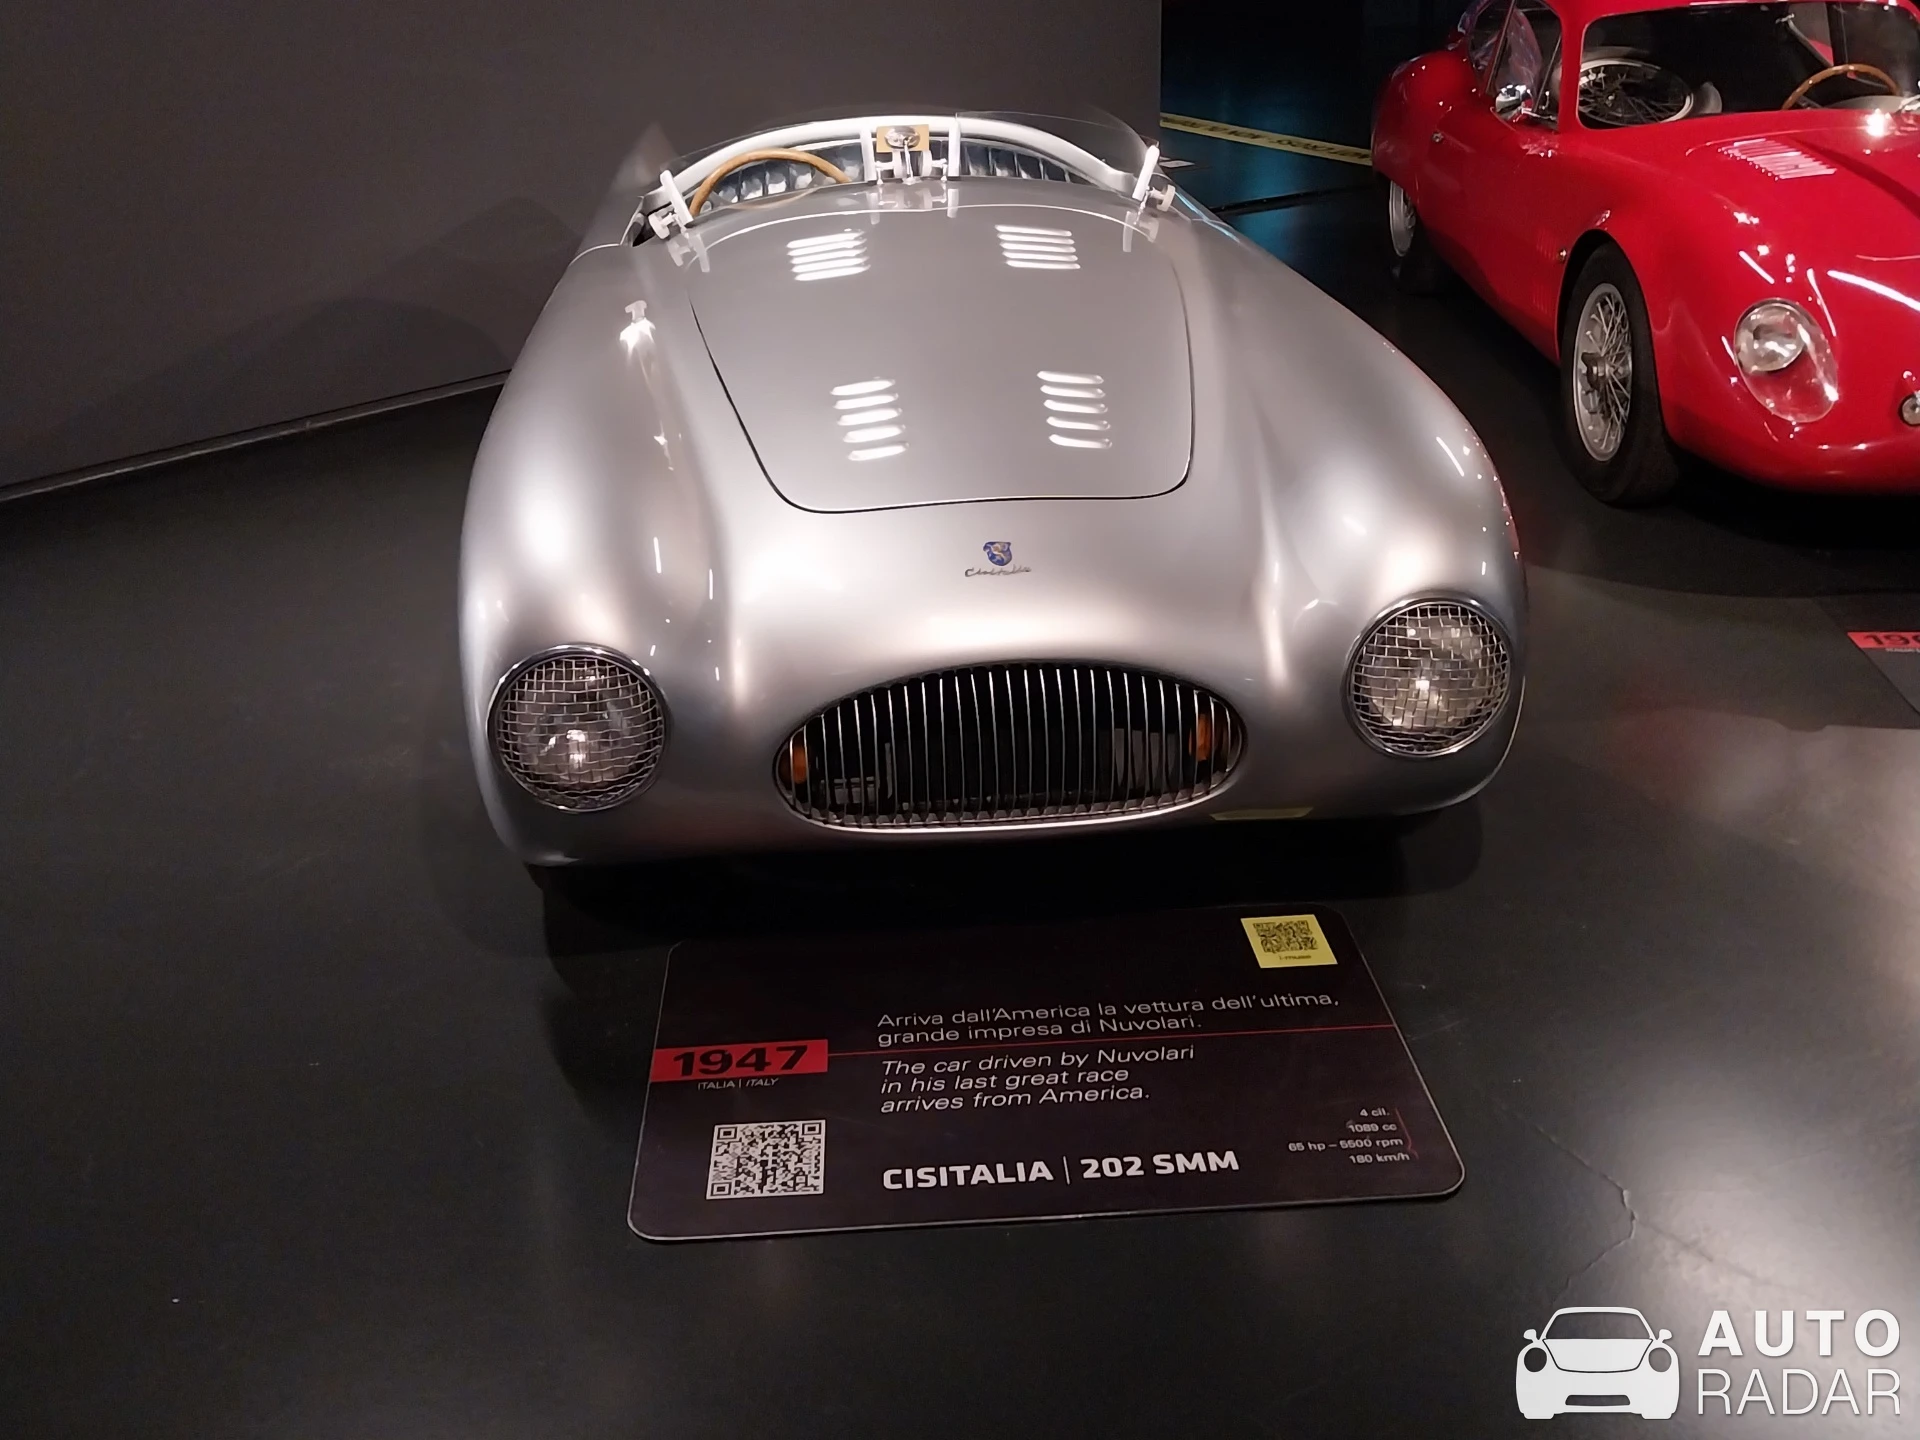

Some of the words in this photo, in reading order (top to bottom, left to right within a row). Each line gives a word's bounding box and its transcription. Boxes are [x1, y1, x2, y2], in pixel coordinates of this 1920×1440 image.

[1864, 634, 1920, 645] 19
[877, 1014, 943, 1027] Arriva
[952, 1005, 1090, 1024] dall'America
[1098, 1003, 1116, 1016] la
[1124, 1000, 1204, 1015] vettura
[878, 1028, 959, 1047] grande
[968, 1024, 1063, 1040] impresa
[1071, 1019, 1091, 1034] di
[1100, 1015, 1202, 1033] Nuvolari.
[673, 1045, 808, 1076] 1947
[882, 1060, 925, 1075] The
[933, 1060, 972, 1073] car
[978, 1055, 1051, 1071] driven
[1060, 1051, 1089, 1068] by
[1097, 1045, 1194, 1064] Nuvolari
[698, 1080, 735, 1090] ITALIA
[746, 1078, 779, 1088] ITALY
[881, 1079, 901, 1094] in
[910, 1077, 946, 1092] his
[955, 1075, 997, 1090] last
[1005, 1070, 1069, 1090] great
[1077, 1069, 1129, 1083] race
[880, 1095, 964, 1114] arrives
[974, 1092, 1031, 1108] from
[1039, 1085, 1150, 1105] America.
[1360, 1108, 1368, 1117] 4
[1371, 1107, 1390, 1116] cil.
[1382, 1123, 1398, 1131] cc
[1307, 1141, 1326, 1152] hp
[1376, 1138, 1403, 1148] rpm
[1376, 1152, 1410, 1162] km/h
[883, 1160, 1054, 1190] CISITALIA
[1080, 1156, 1145, 1179] 202
[1153, 1151, 1239, 1175] SMM
